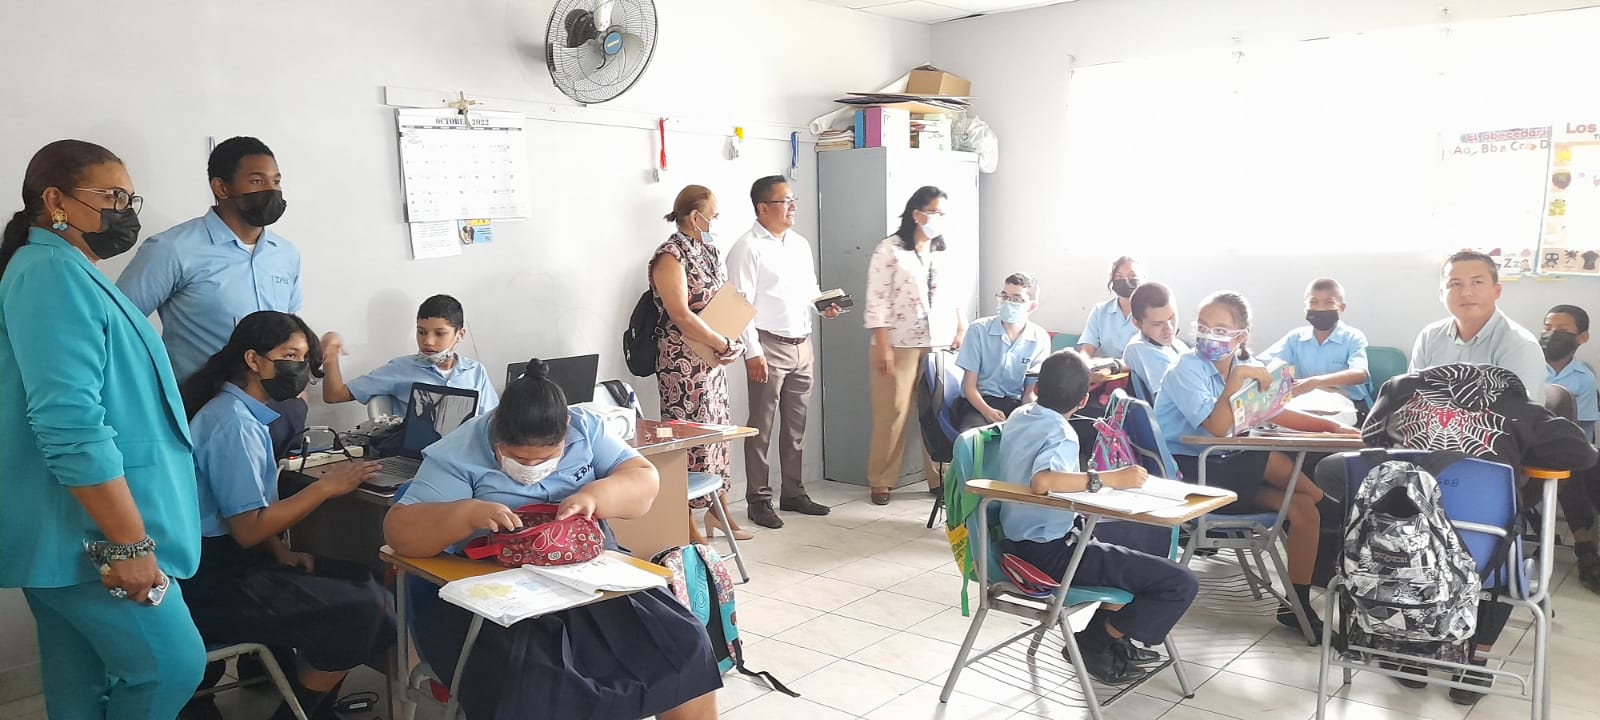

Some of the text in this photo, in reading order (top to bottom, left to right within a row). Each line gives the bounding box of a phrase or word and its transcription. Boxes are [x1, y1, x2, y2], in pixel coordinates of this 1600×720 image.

[471, 118, 490, 126] 2022
[1565, 121, 1598, 135] Los
[1466, 132, 1478, 142] El
